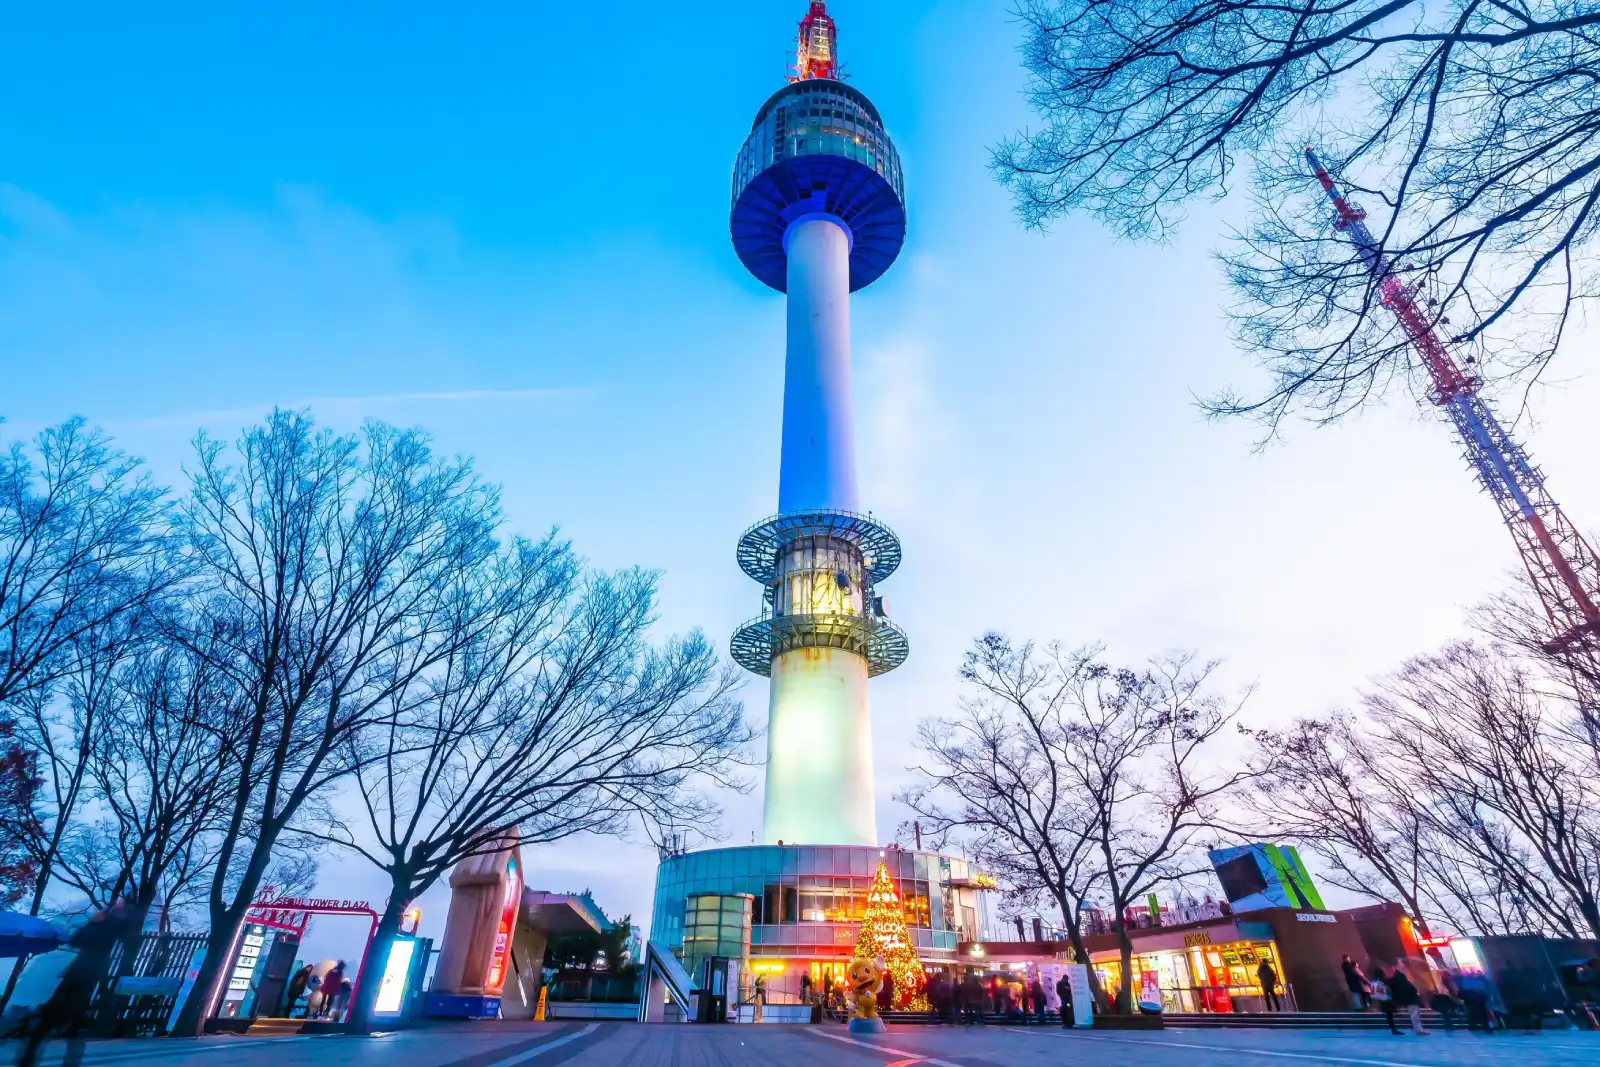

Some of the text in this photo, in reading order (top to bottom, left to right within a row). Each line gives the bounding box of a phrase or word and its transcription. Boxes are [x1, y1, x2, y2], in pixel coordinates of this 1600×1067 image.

[309, 898, 339, 908] TOWER
[342, 900, 370, 910] PLAZA
[874, 922, 905, 932] KLOOK
